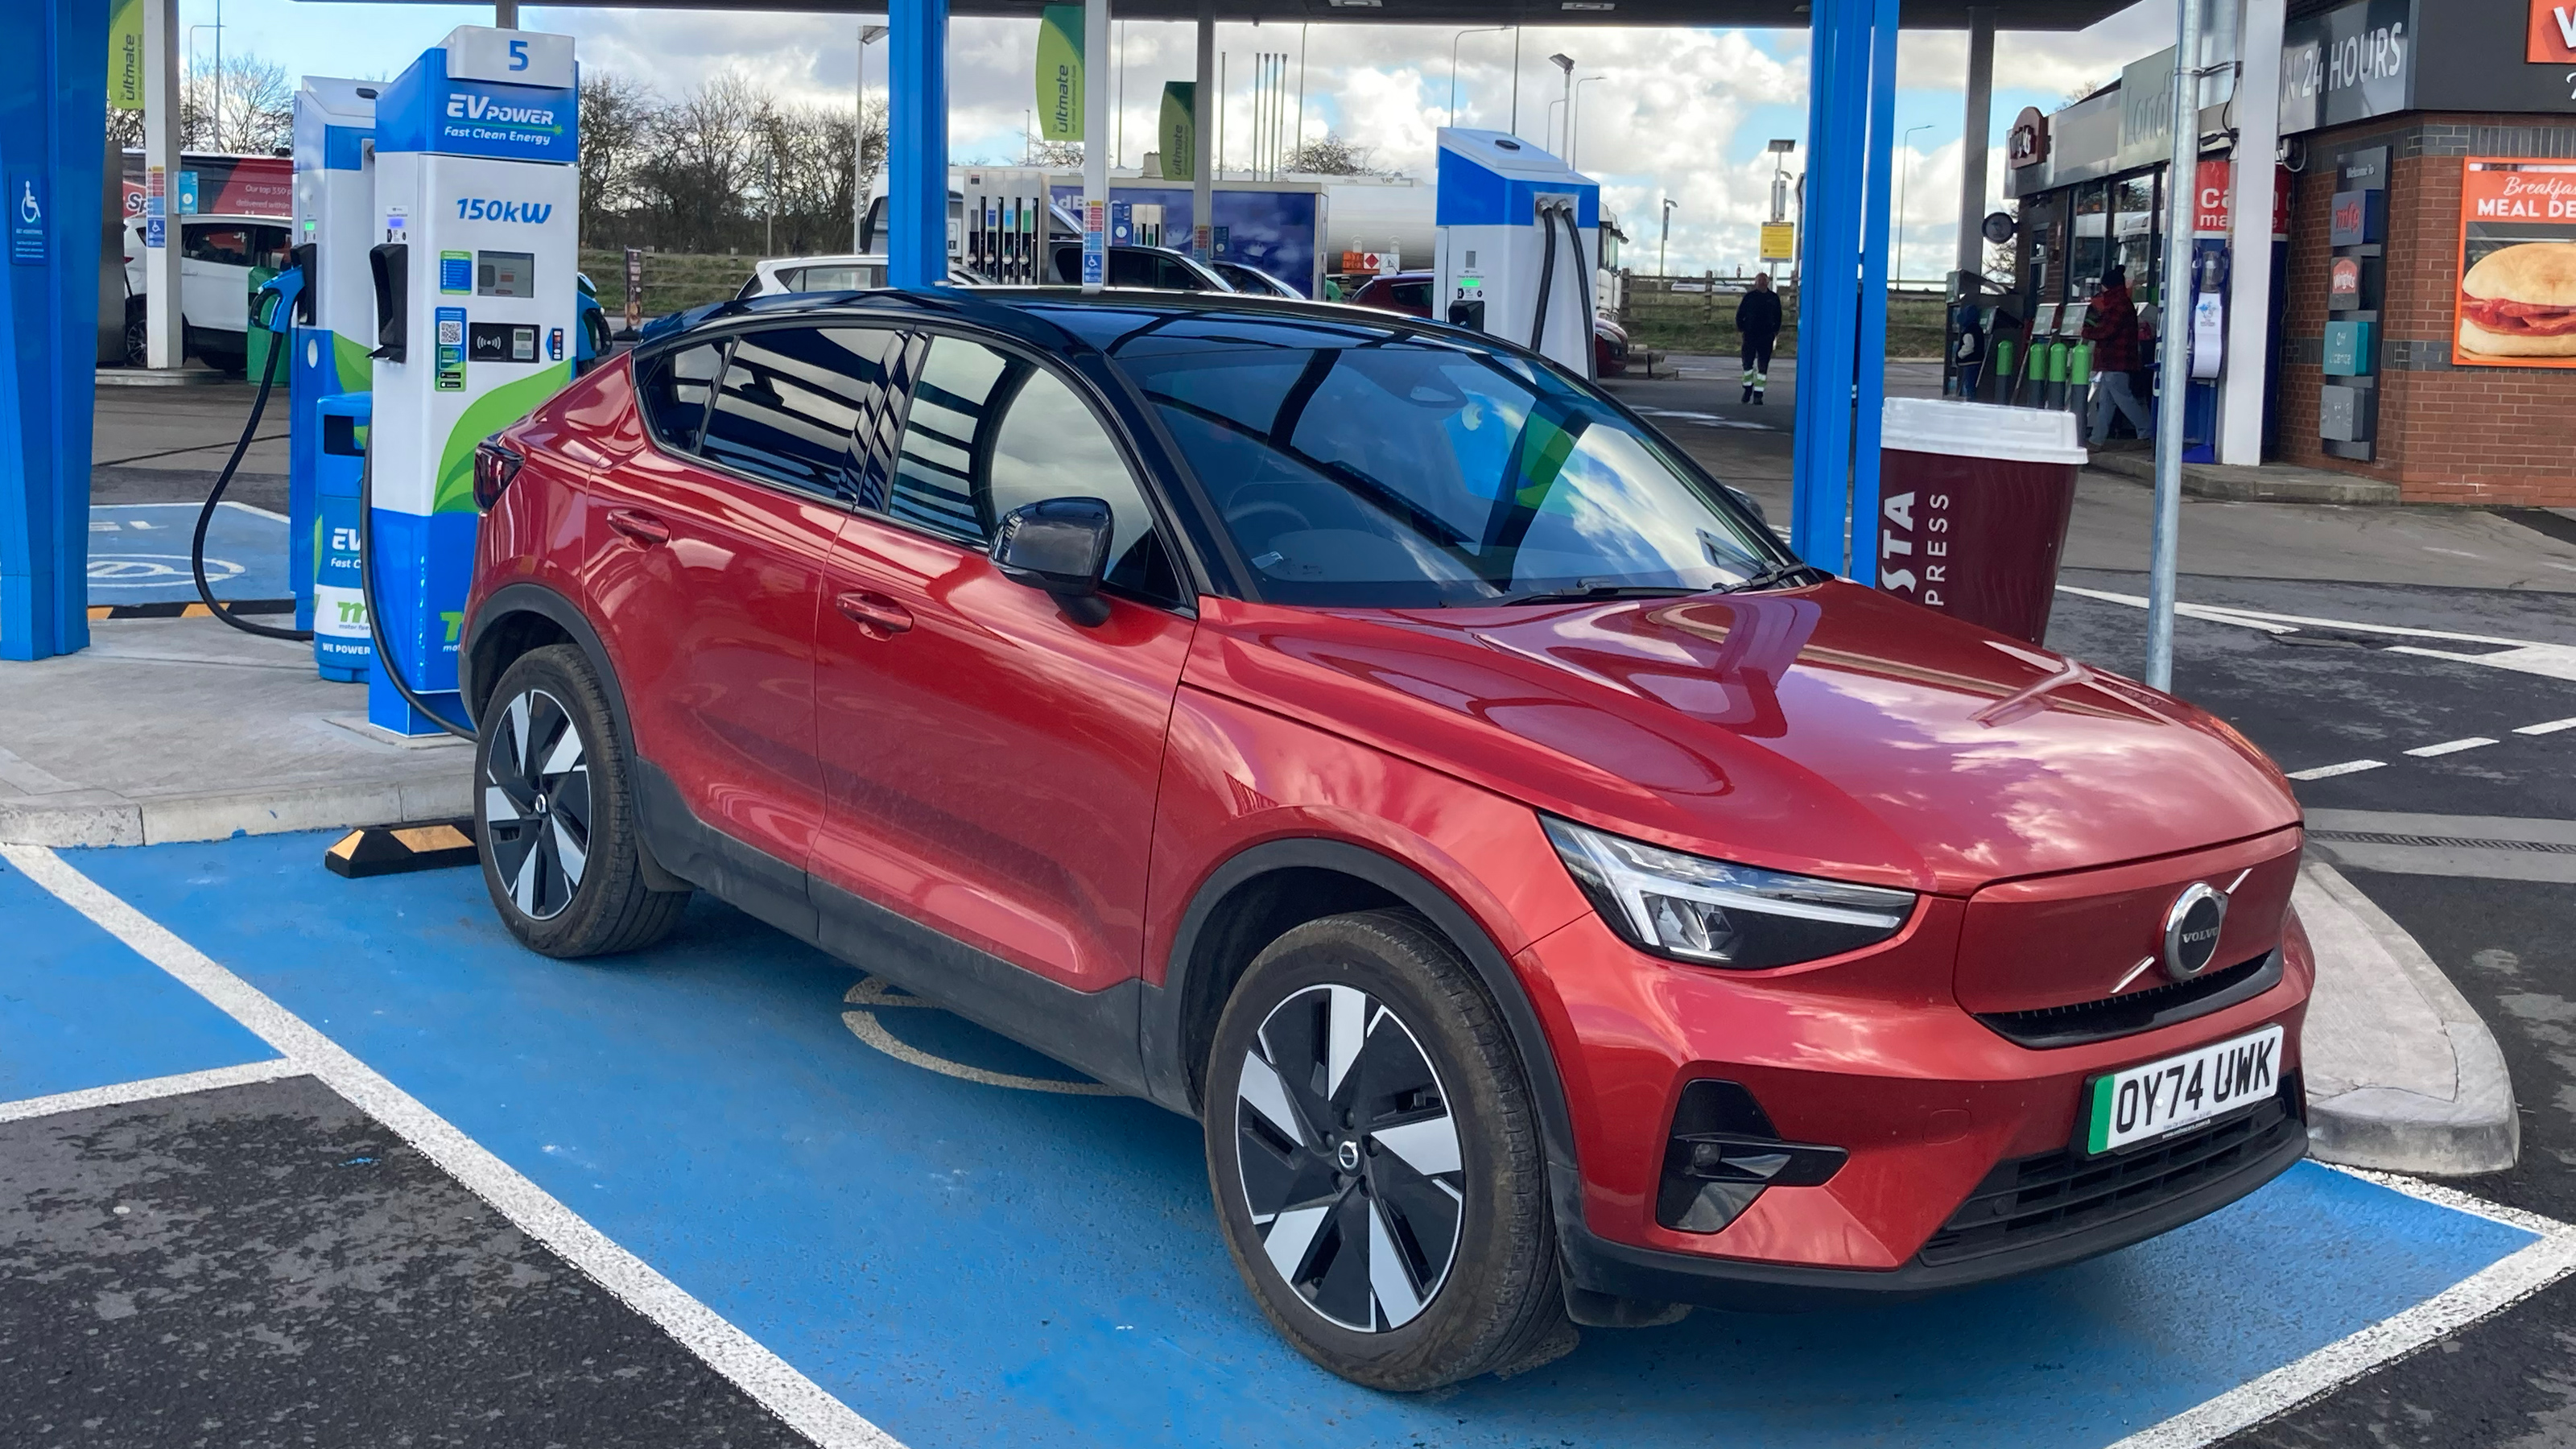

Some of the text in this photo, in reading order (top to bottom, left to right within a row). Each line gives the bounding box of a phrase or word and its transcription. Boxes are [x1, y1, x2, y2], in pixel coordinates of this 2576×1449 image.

[122, 34, 135, 101] ultimate
[509, 40, 529, 71] 5
[2301, 49, 2323, 94] 24
[2329, 22, 2402, 92] HOURS
[1056, 64, 1069, 134] ultimate
[444, 126, 551, 146] Fast Clean Energy
[1172, 125, 1183, 176] ultimate
[456, 198, 552, 224] 150kW
[2477, 198, 2576, 218] MEAL DE
[331, 557, 352, 569] Fast
[1925, 494, 1950, 606] PRESS
[322, 642, 371, 656] WE POWER
[2182, 925, 2219, 944] VOLVO
[2116, 1036, 2276, 1134] OY74 UWK
